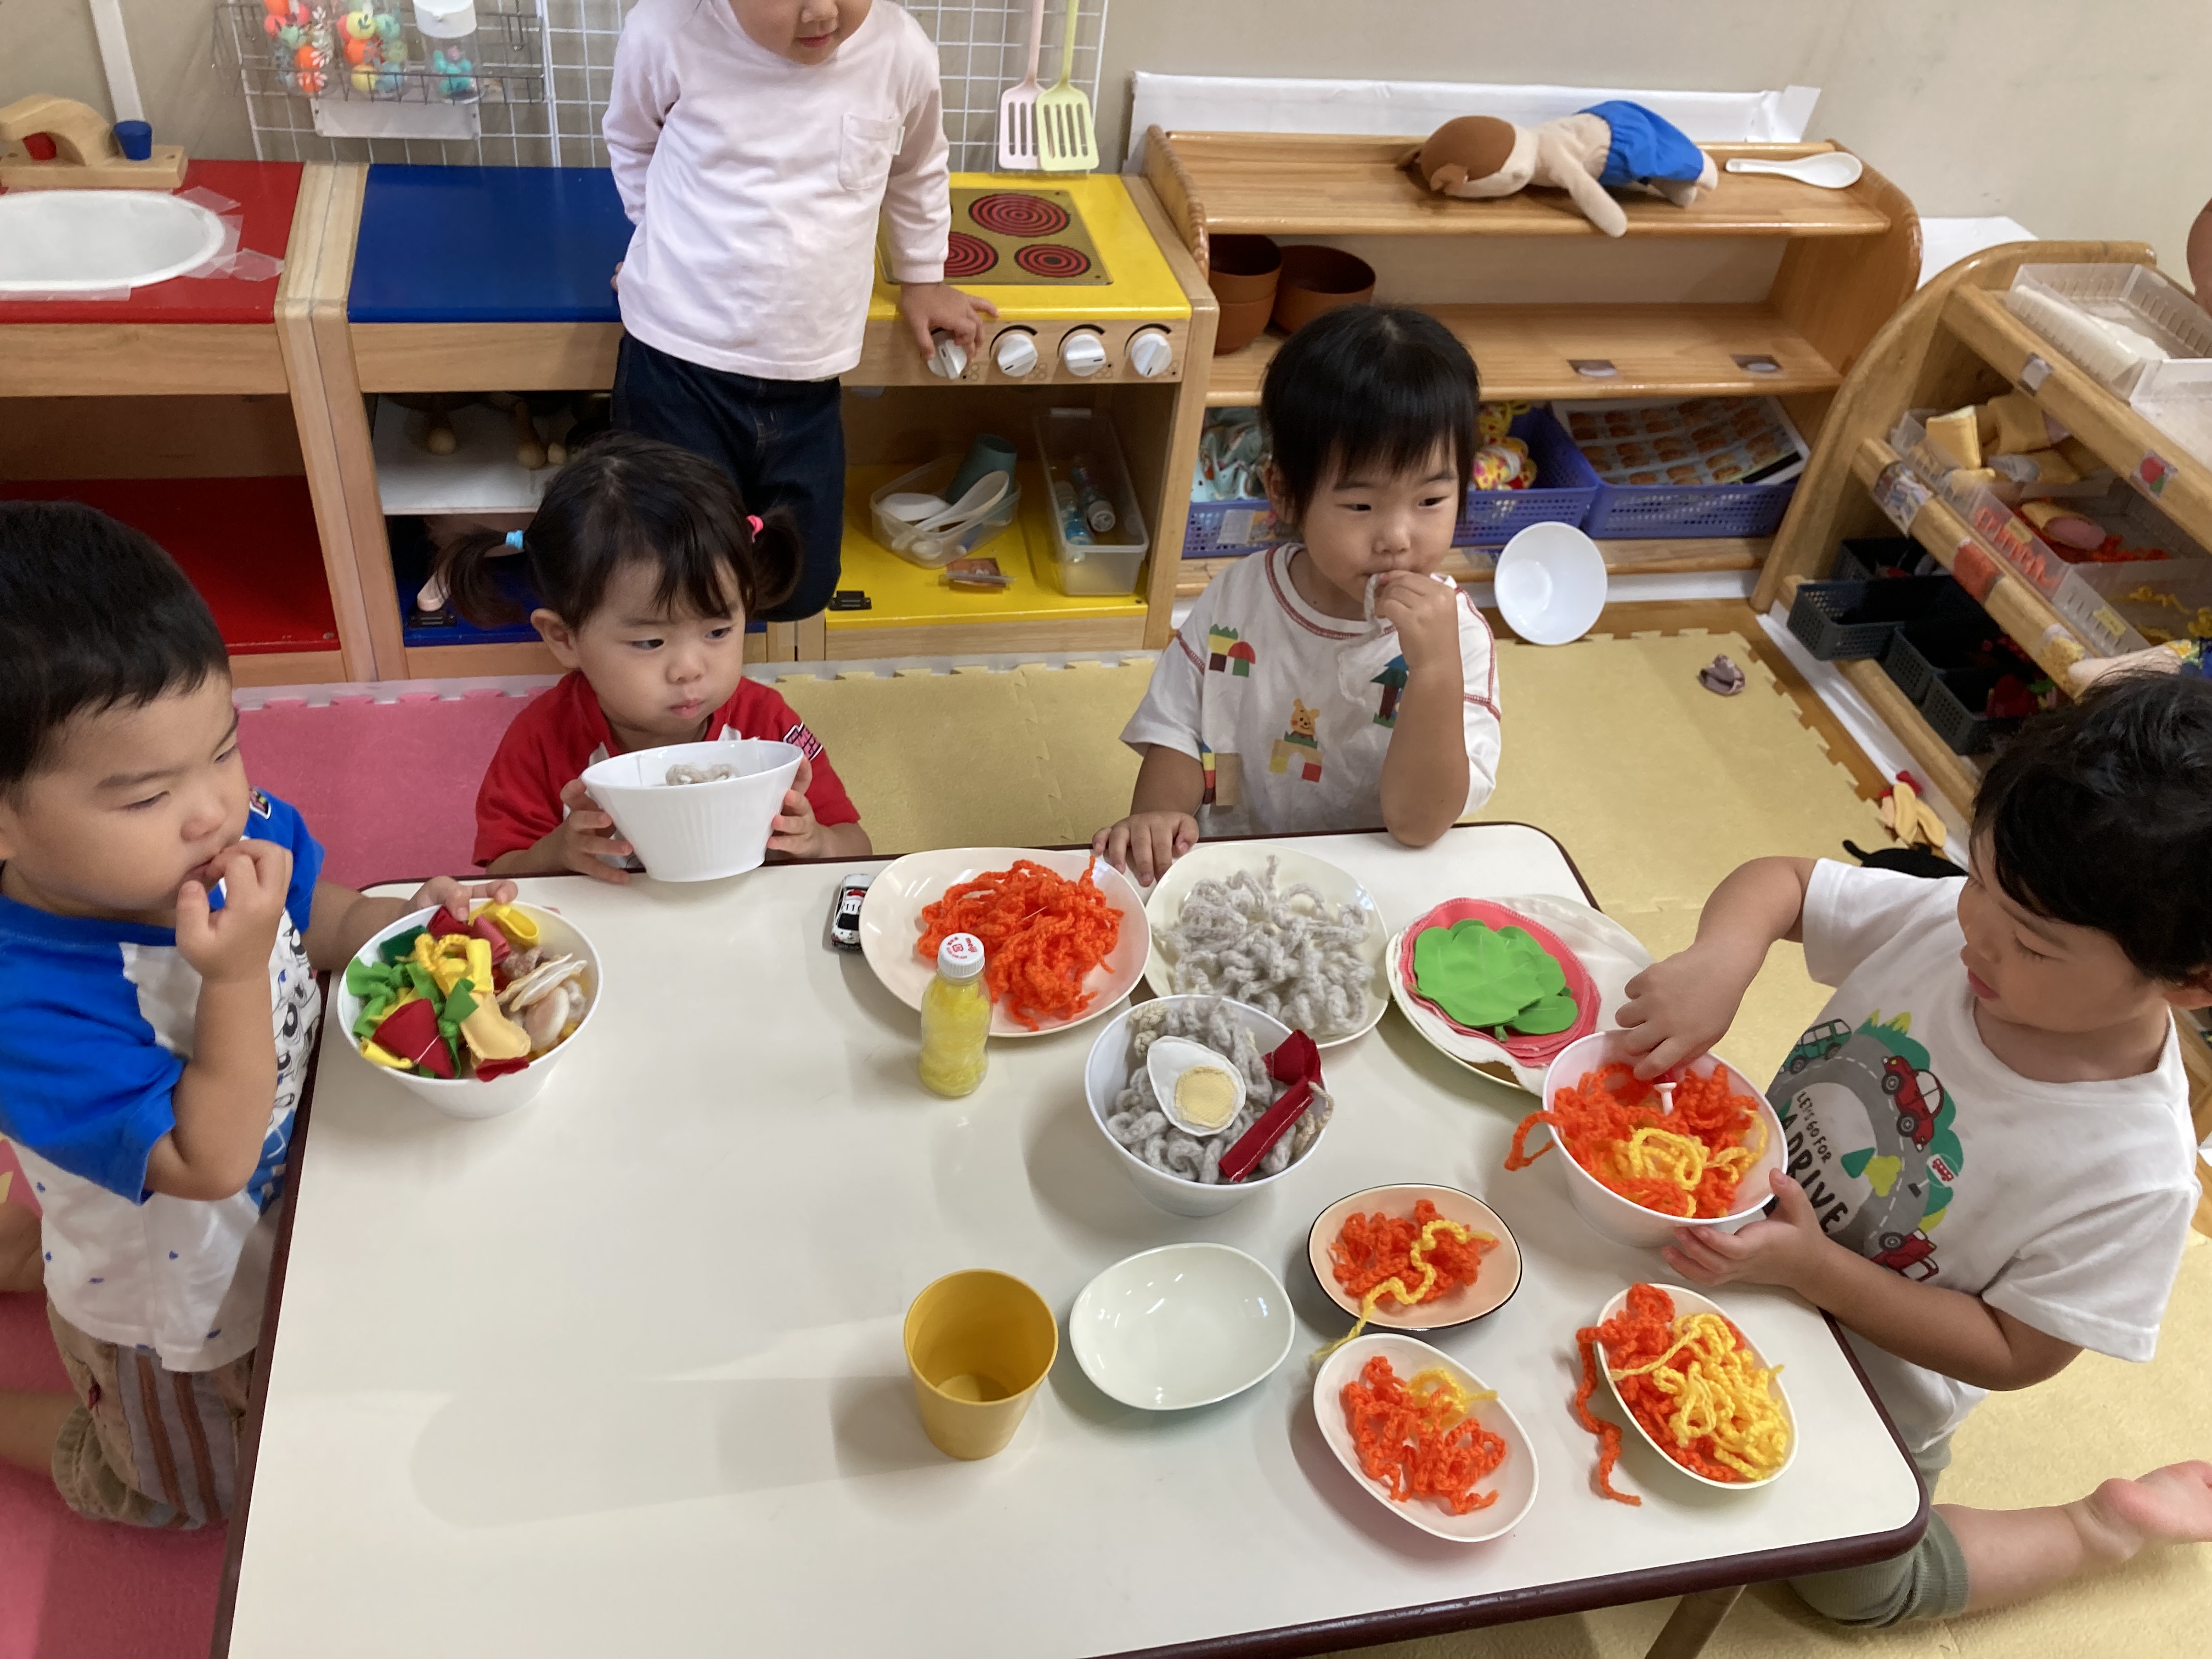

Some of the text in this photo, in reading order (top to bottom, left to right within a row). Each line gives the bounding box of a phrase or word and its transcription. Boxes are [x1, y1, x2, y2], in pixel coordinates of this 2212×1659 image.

[1806, 1121, 1820, 1137] GO
[1813, 1136, 1831, 1164] FOR
[1786, 1131, 1848, 1233] DRIVE
